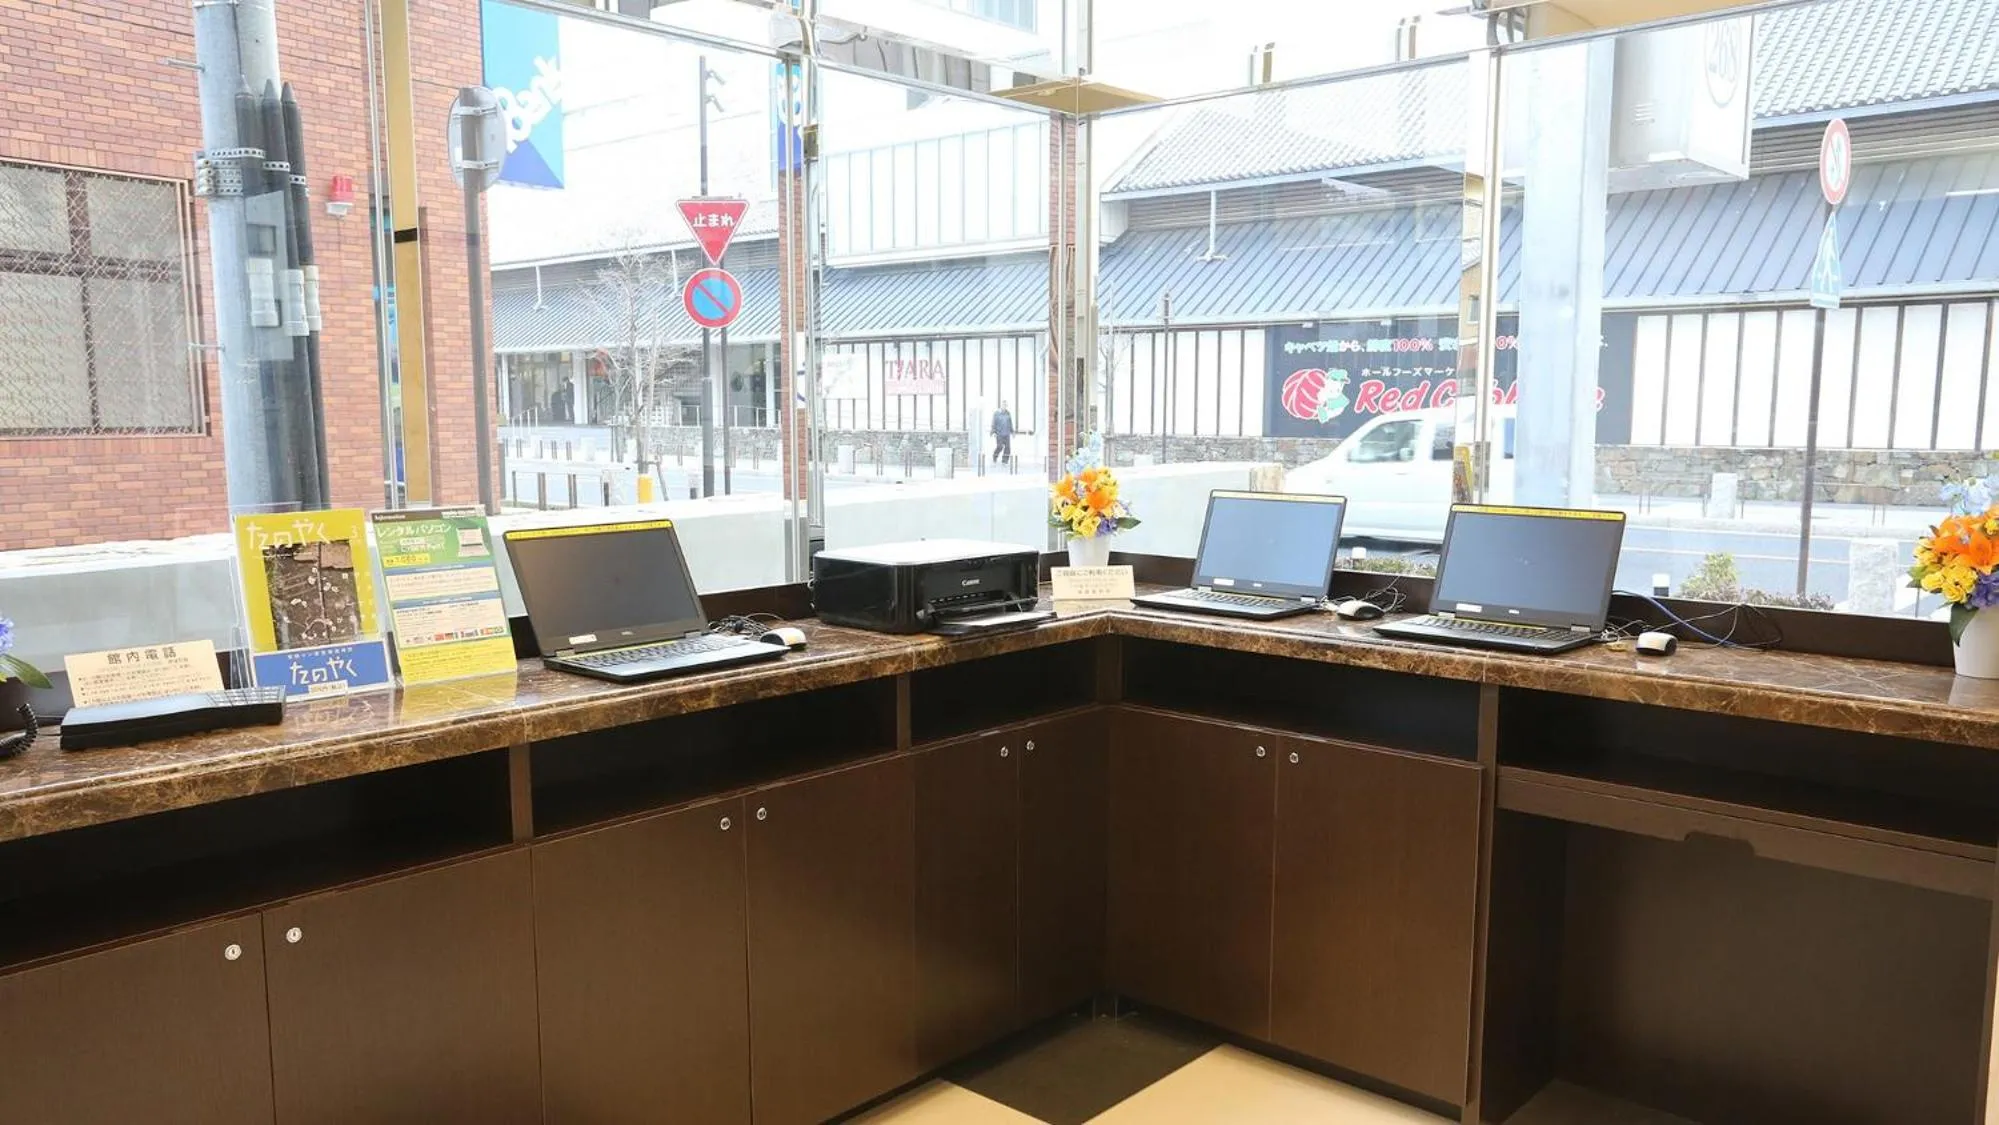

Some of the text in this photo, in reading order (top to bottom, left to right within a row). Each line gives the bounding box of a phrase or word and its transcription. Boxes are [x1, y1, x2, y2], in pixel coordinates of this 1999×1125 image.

[693, 212, 736, 228] 止まれ
[885, 359, 946, 380] TIARA
[1354, 379, 1431, 414] Red
[376, 522, 452, 538] レンタルパソコン
[106, 646, 178, 665] 館内電話
